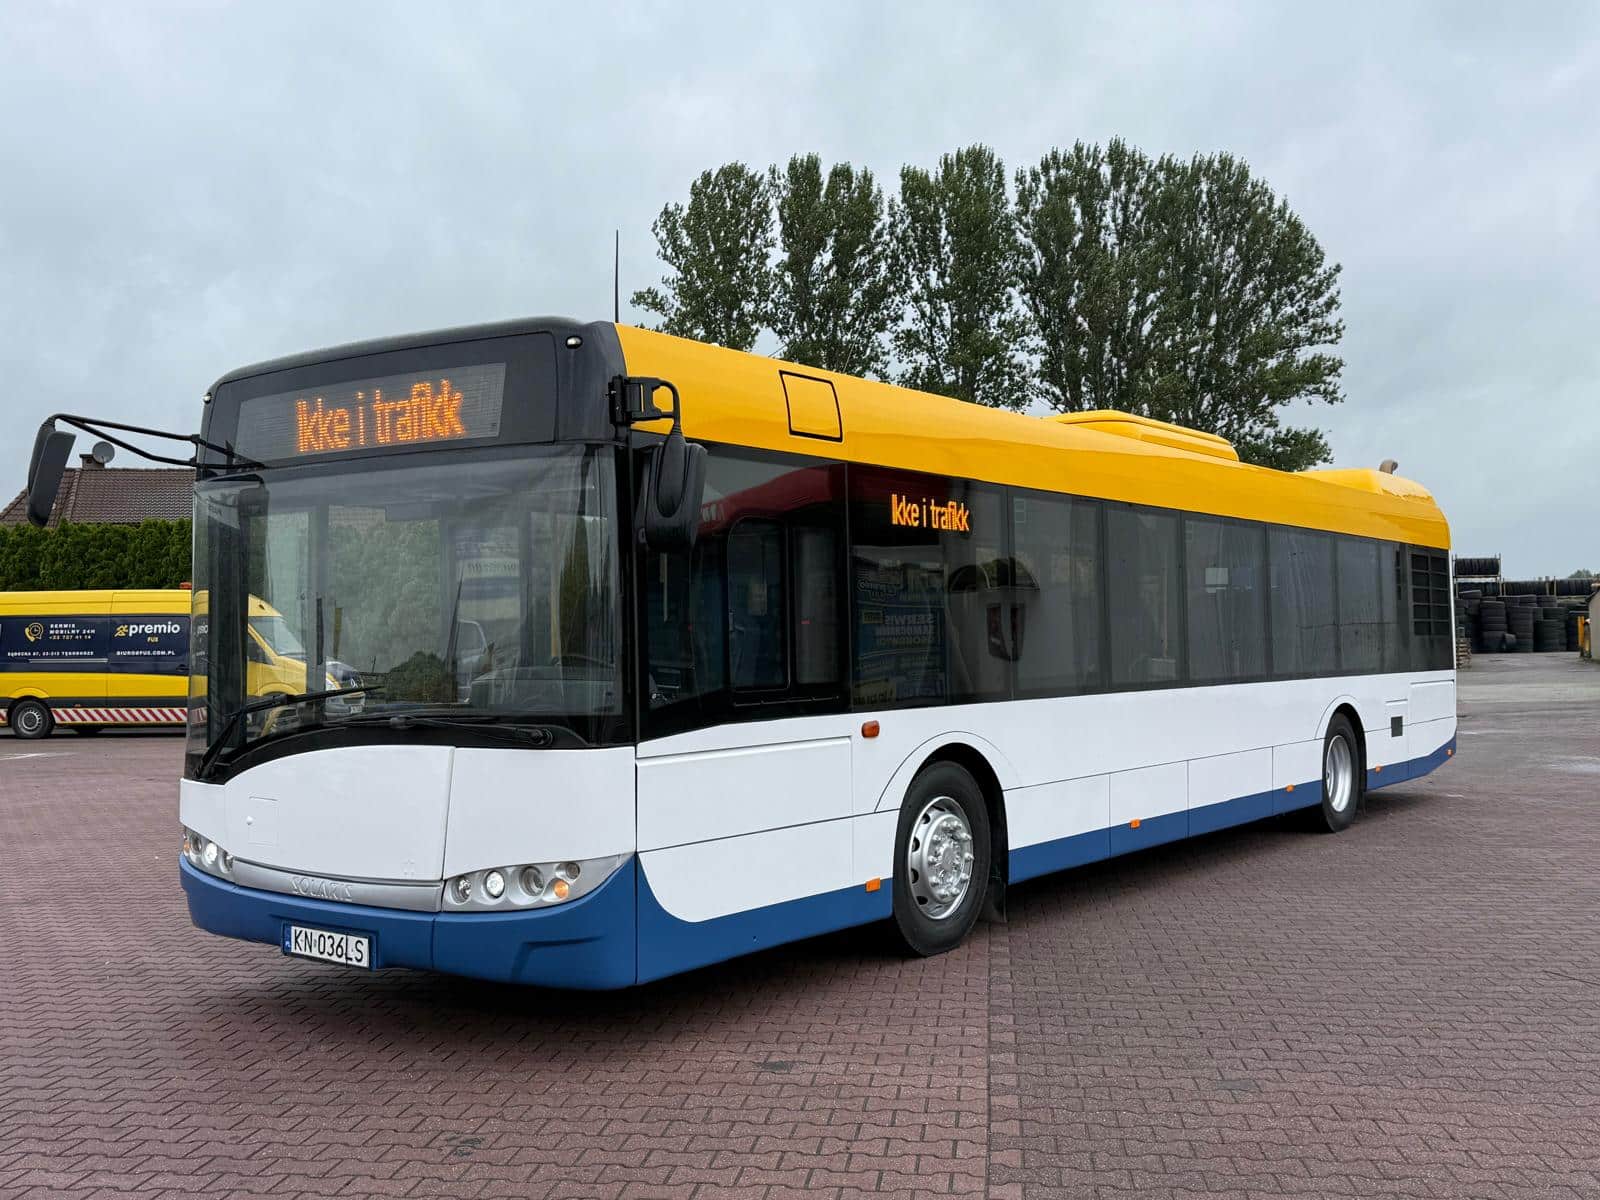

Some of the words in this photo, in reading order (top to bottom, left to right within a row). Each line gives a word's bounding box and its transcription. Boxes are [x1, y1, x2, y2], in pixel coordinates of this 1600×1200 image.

[295, 398, 351, 452] Ikke
[356, 391, 366, 446] i
[372, 378, 466, 445] trafikk
[891, 493, 920, 527] Ikke
[922, 497, 928, 528] i
[930, 498, 970, 532] trafikk
[128, 621, 180, 637] premio
